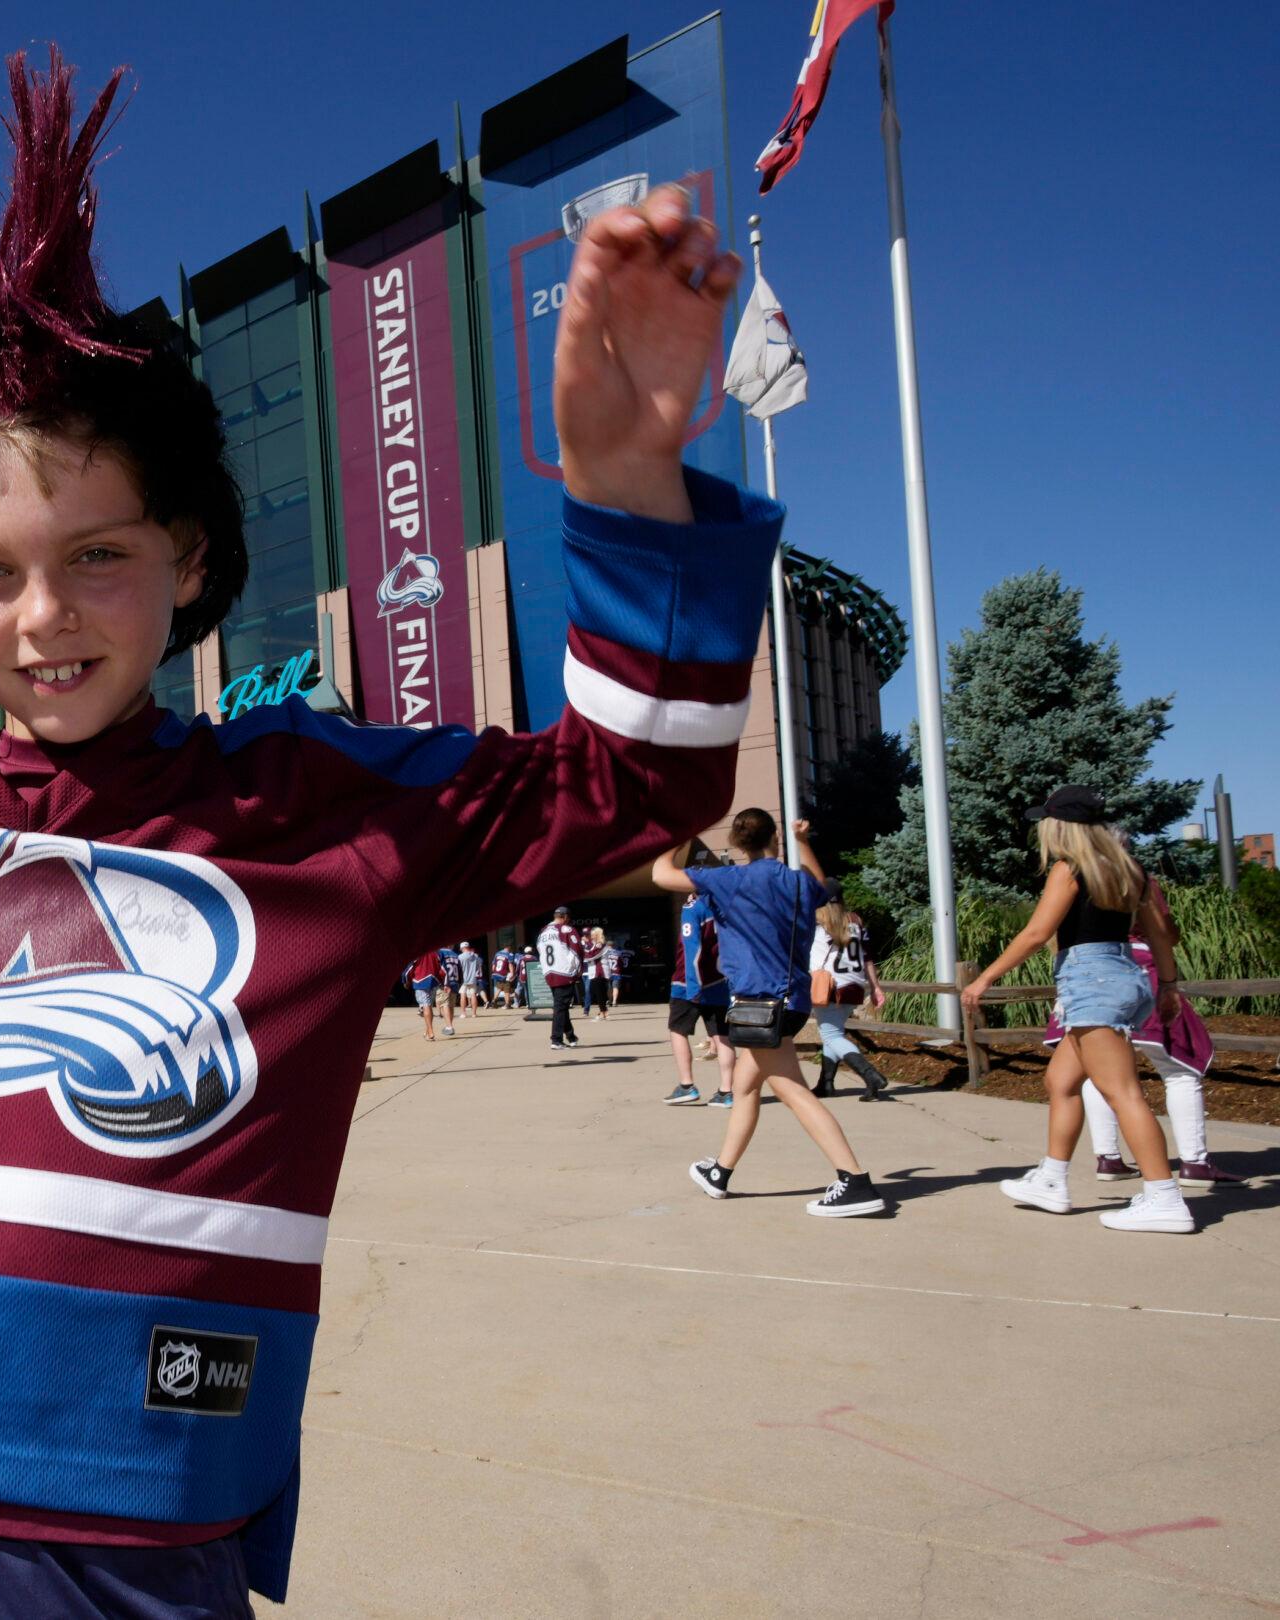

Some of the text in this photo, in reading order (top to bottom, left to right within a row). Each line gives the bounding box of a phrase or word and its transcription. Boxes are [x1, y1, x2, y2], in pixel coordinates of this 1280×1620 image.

[373, 268, 415, 447] STANLEY
[386, 460, 420, 539] CUP
[682, 922, 691, 937] 8
[545, 945, 554, 966] 8
[167, 1356, 193, 1384] NHL
[205, 1360, 249, 1388] NHL
